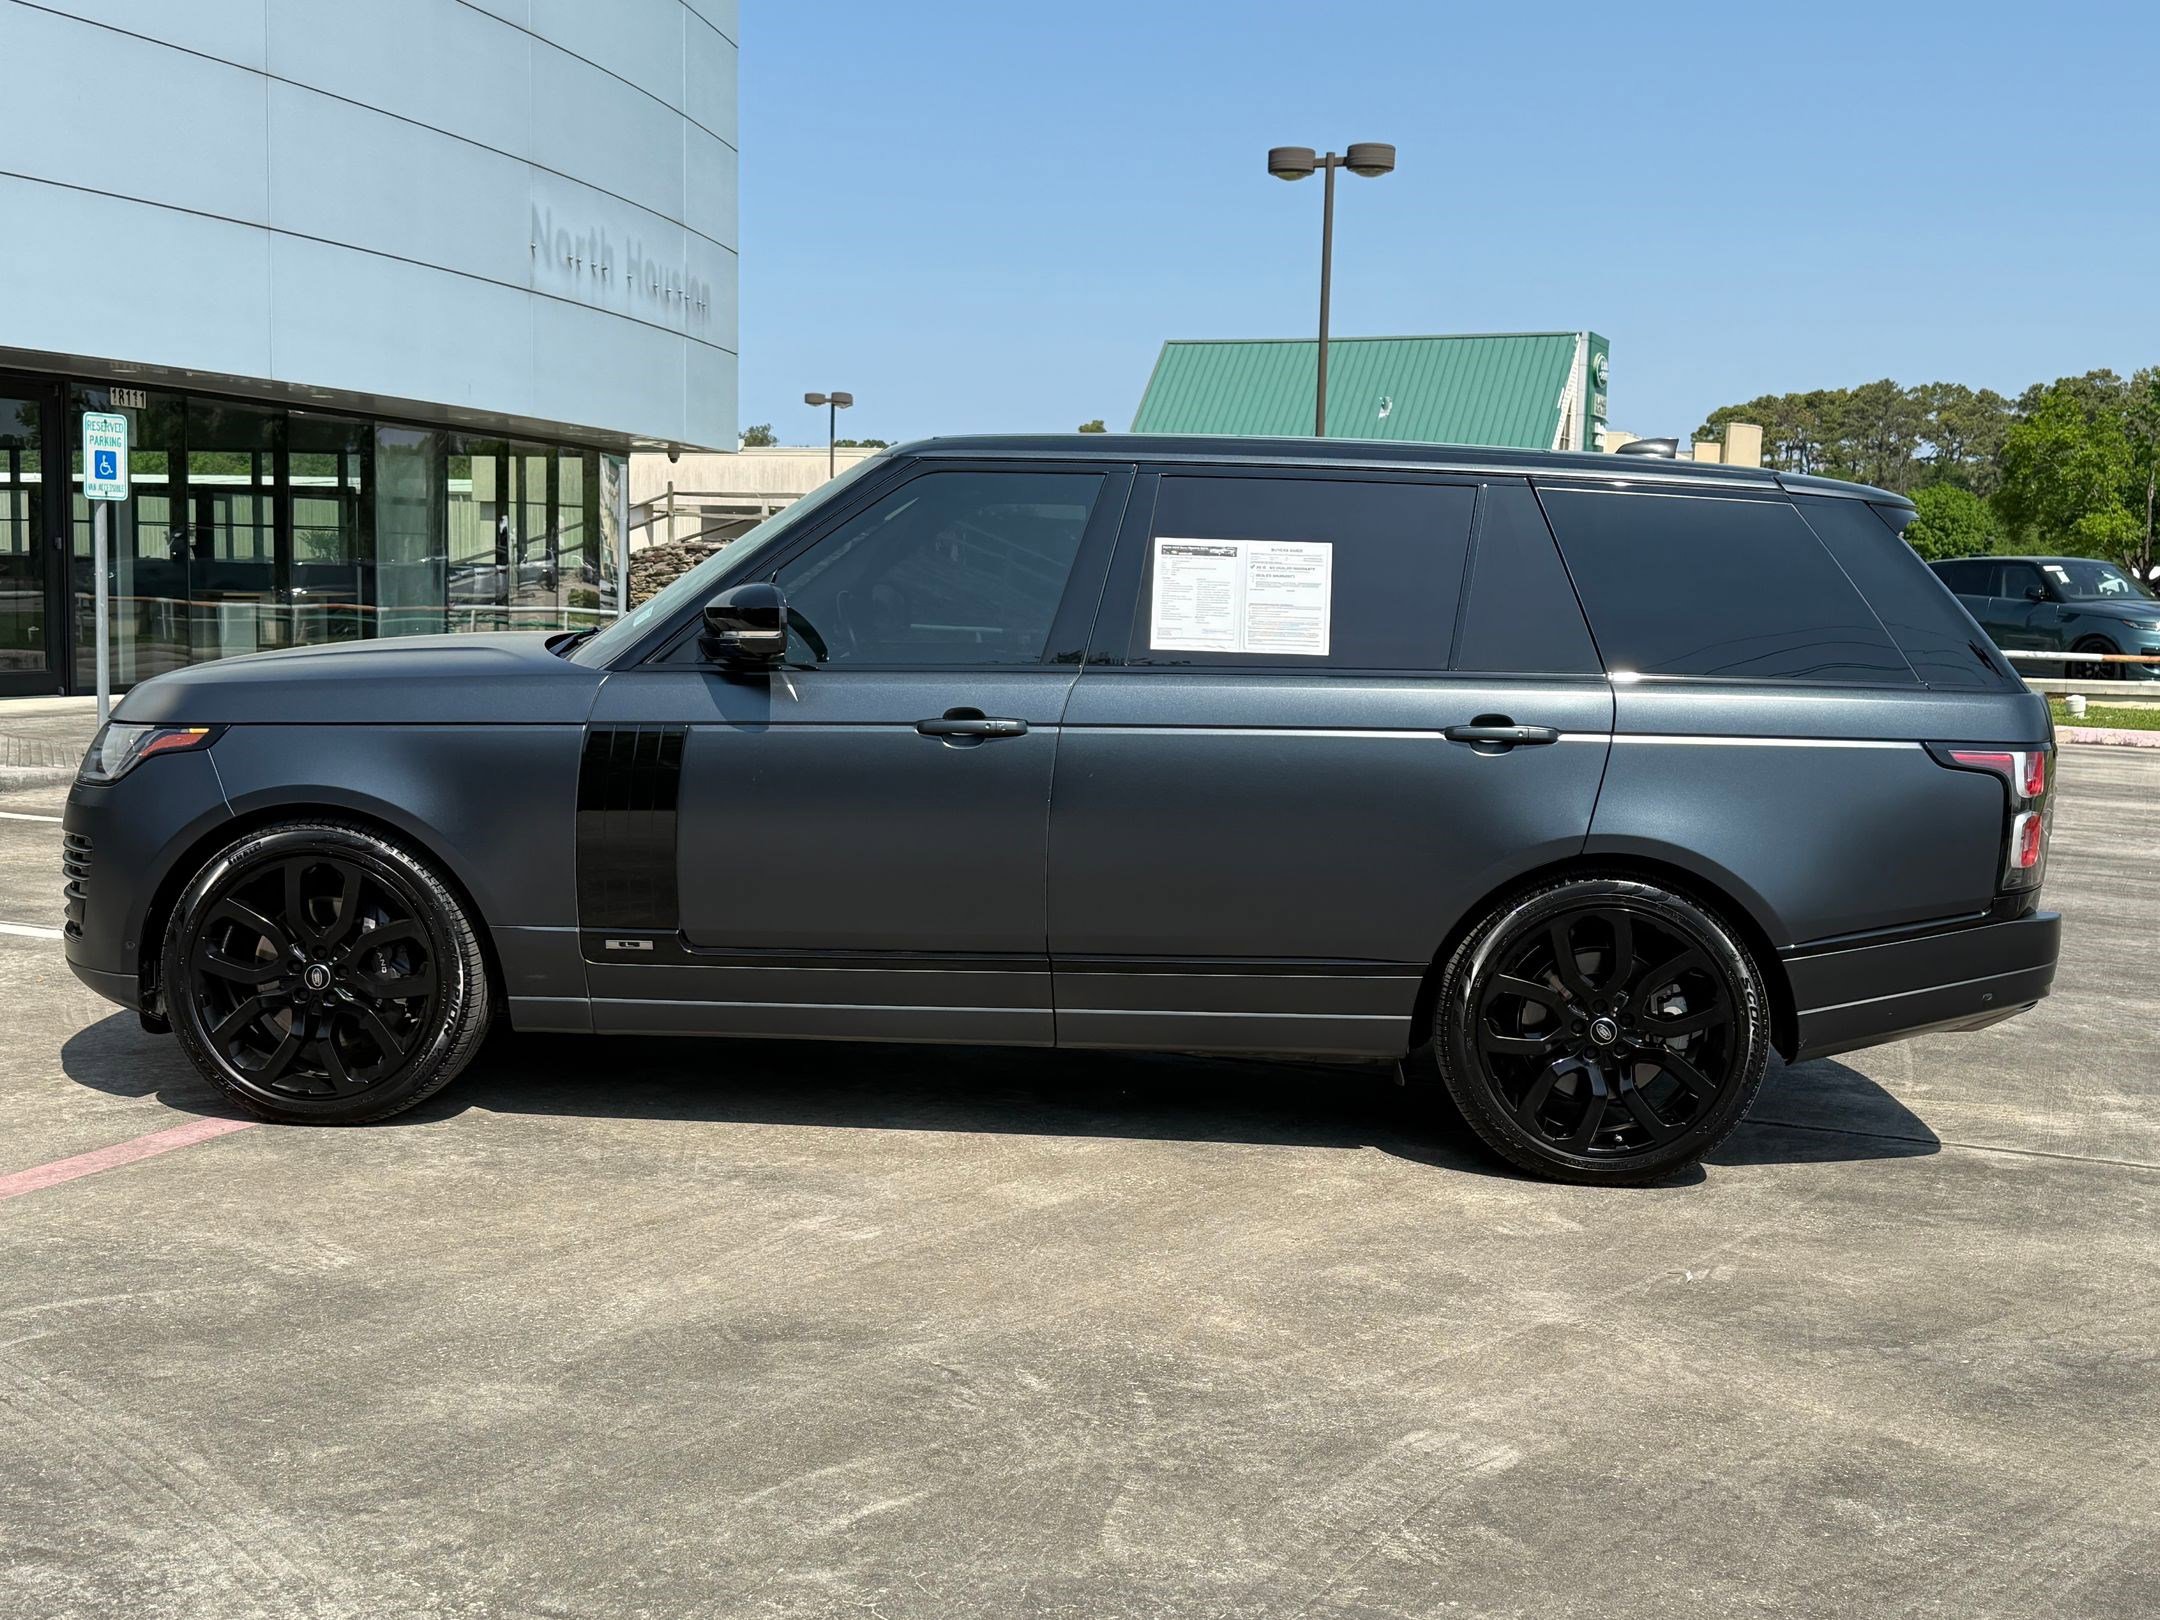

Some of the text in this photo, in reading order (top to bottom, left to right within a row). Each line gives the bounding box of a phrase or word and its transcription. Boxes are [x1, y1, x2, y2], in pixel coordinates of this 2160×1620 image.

[530, 201, 615, 292] North
[112, 387, 145, 407] 18111
[86, 419, 124, 433] RESERVED
[89, 435, 122, 448] PARKING
